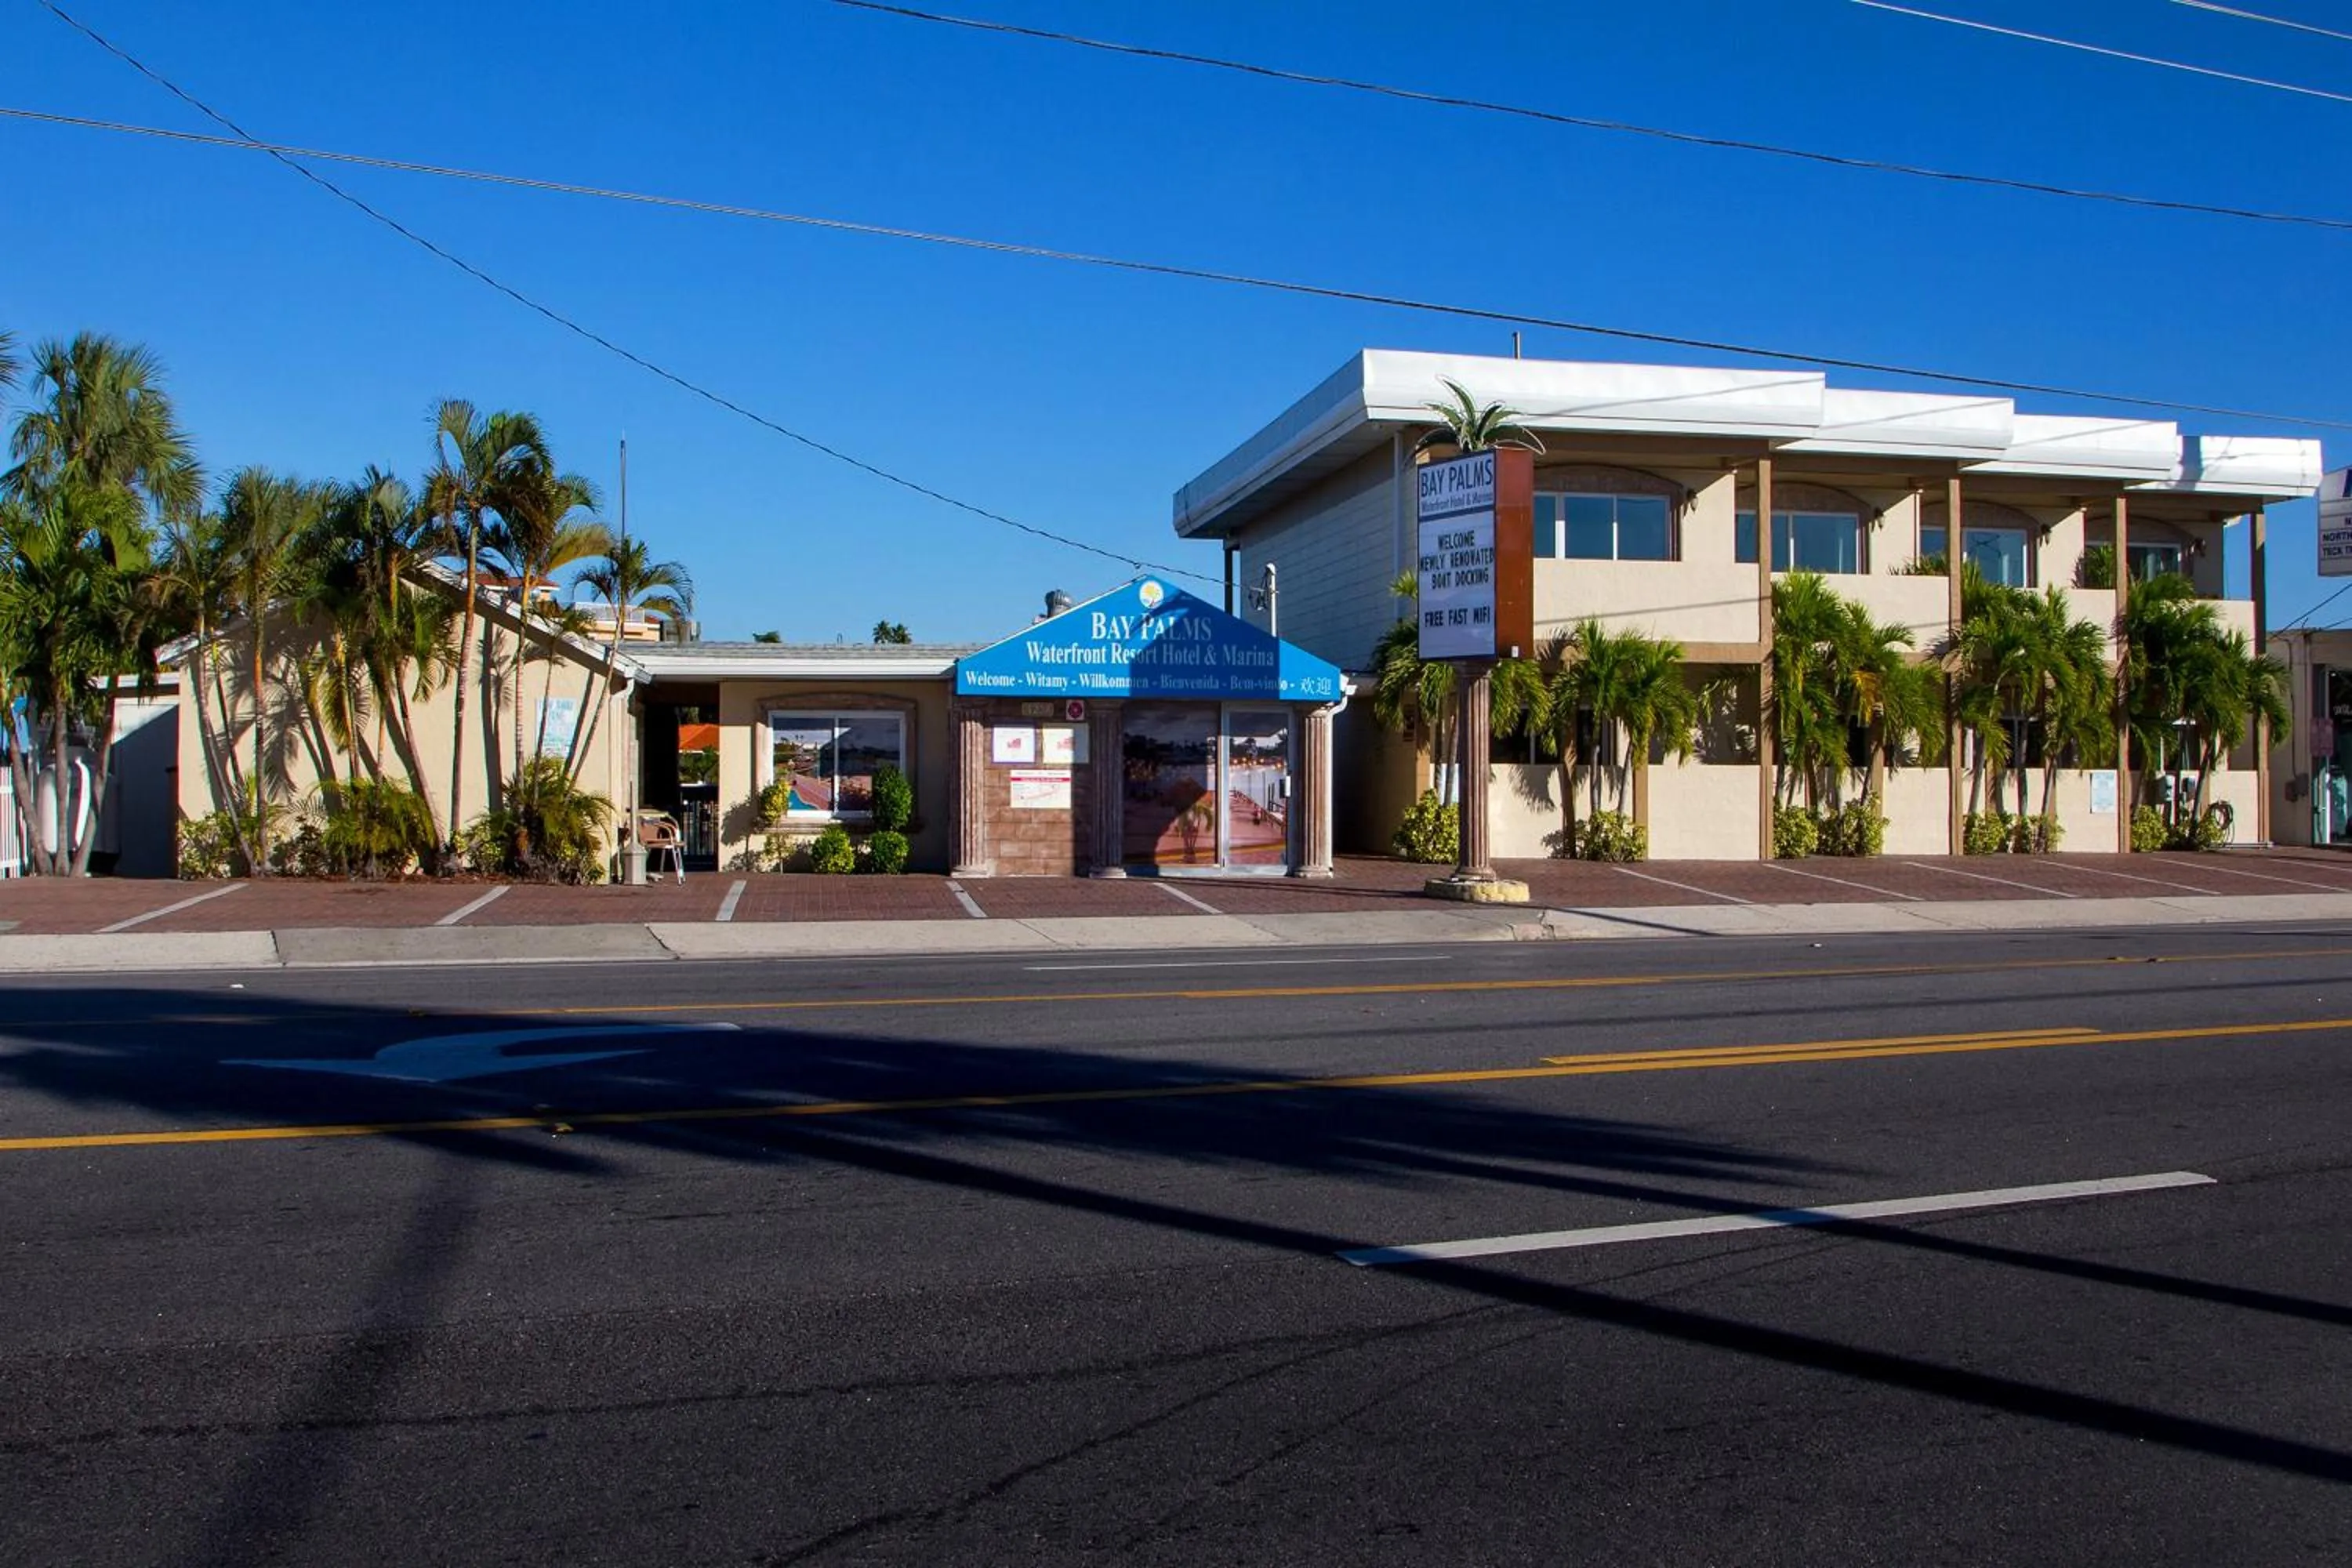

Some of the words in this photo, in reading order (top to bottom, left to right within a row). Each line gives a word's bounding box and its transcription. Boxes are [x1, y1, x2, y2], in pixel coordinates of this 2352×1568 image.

[1420, 468, 1445, 498] BAY
[1448, 459, 1494, 492] PALMS
[1438, 530, 1475, 550] WELCOME
[1420, 554, 1446, 572] NEWLY
[1450, 547, 1494, 568] RENOVATED
[1432, 572, 1451, 590] BOAT
[1455, 568, 1489, 587] DOCKING
[1091, 612, 1134, 640] BAY
[1140, 612, 1212, 641] PALMS
[1425, 610, 1443, 628] FREE
[1448, 608, 1468, 626] FAST
[1473, 605, 1490, 625] WIFI
[1026, 641, 1106, 664] Waterfront
[1111, 642, 1158, 665] Resort
[1163, 644, 1200, 666] Hotel
[1203, 644, 1217, 666] &
[1223, 644, 1275, 666] Marina
[966, 670, 1015, 687] Welcome
[1025, 672, 1068, 691] Witamy
[1079, 673, 1149, 688] Willkommen
[1160, 674, 1219, 689] Bienvenida
[1300, 677, 1332, 695] 欢迎
